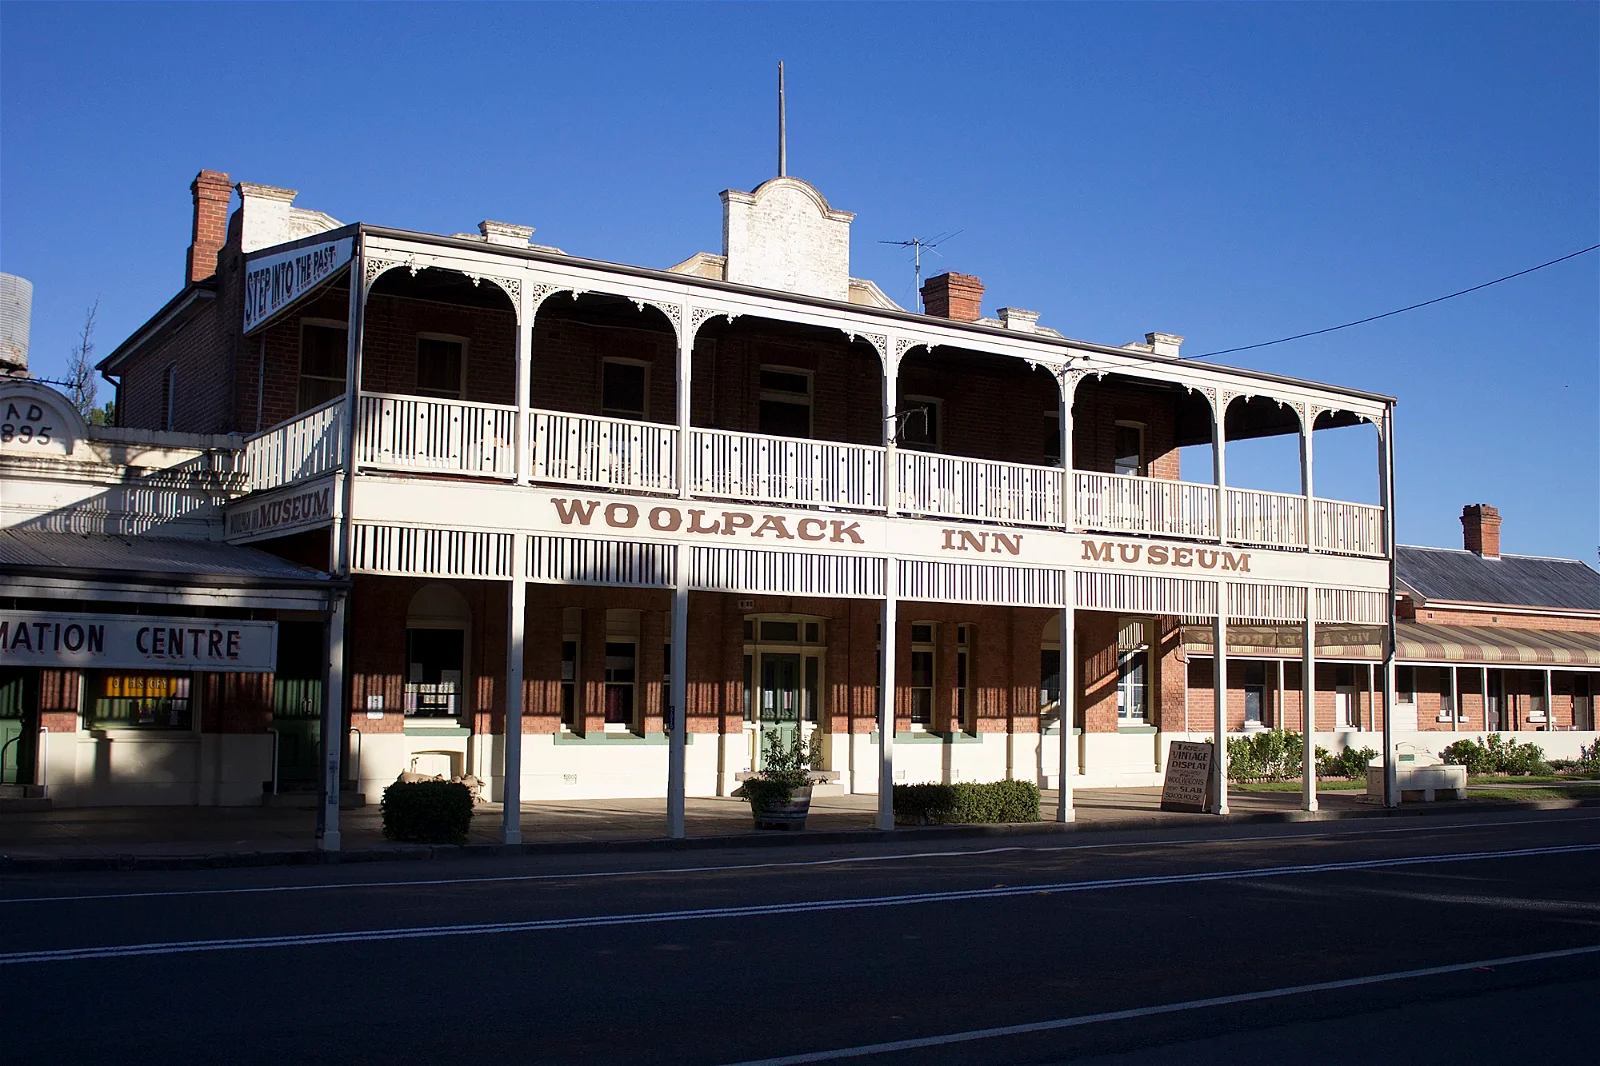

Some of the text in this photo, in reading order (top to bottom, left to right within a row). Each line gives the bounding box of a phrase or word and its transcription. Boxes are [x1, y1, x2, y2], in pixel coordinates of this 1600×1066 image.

[246, 245, 336, 321] STEP INTO THE PAST
[259, 487, 330, 528] MUSEUM
[550, 497, 1251, 573] WOOLPACK INN MUSEUM
[136, 626, 241, 659] CENTRE
[1172, 761, 1208, 770] DISPLAY
[1173, 751, 1208, 761] VINTAGE
[1180, 786, 1202, 794] SLAB
